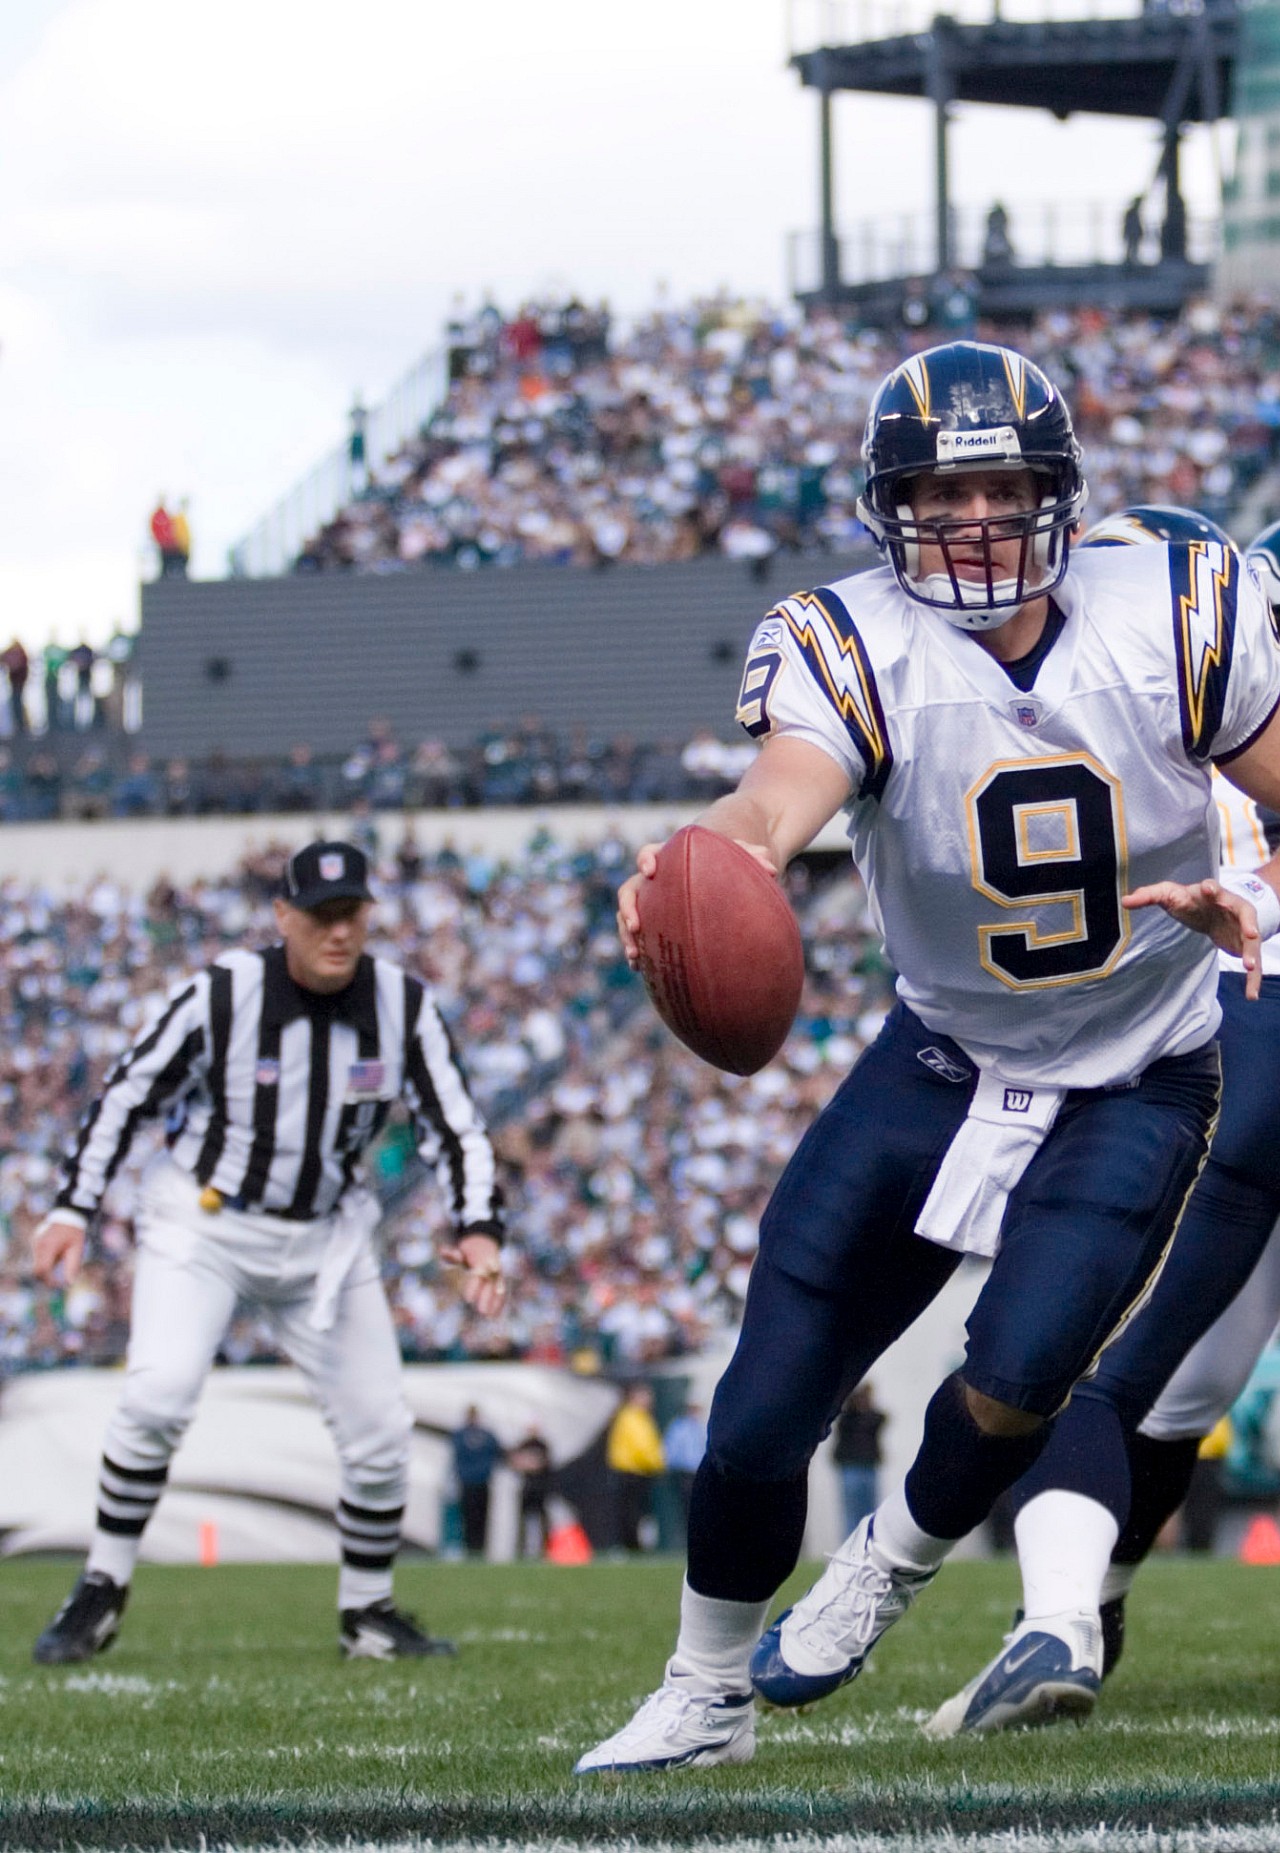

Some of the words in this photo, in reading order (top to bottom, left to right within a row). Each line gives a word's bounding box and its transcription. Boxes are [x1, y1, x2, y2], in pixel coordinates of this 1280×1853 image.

[954, 435, 997, 448] Riddell
[736, 648, 786, 740] 9
[965, 752, 1131, 991] 9
